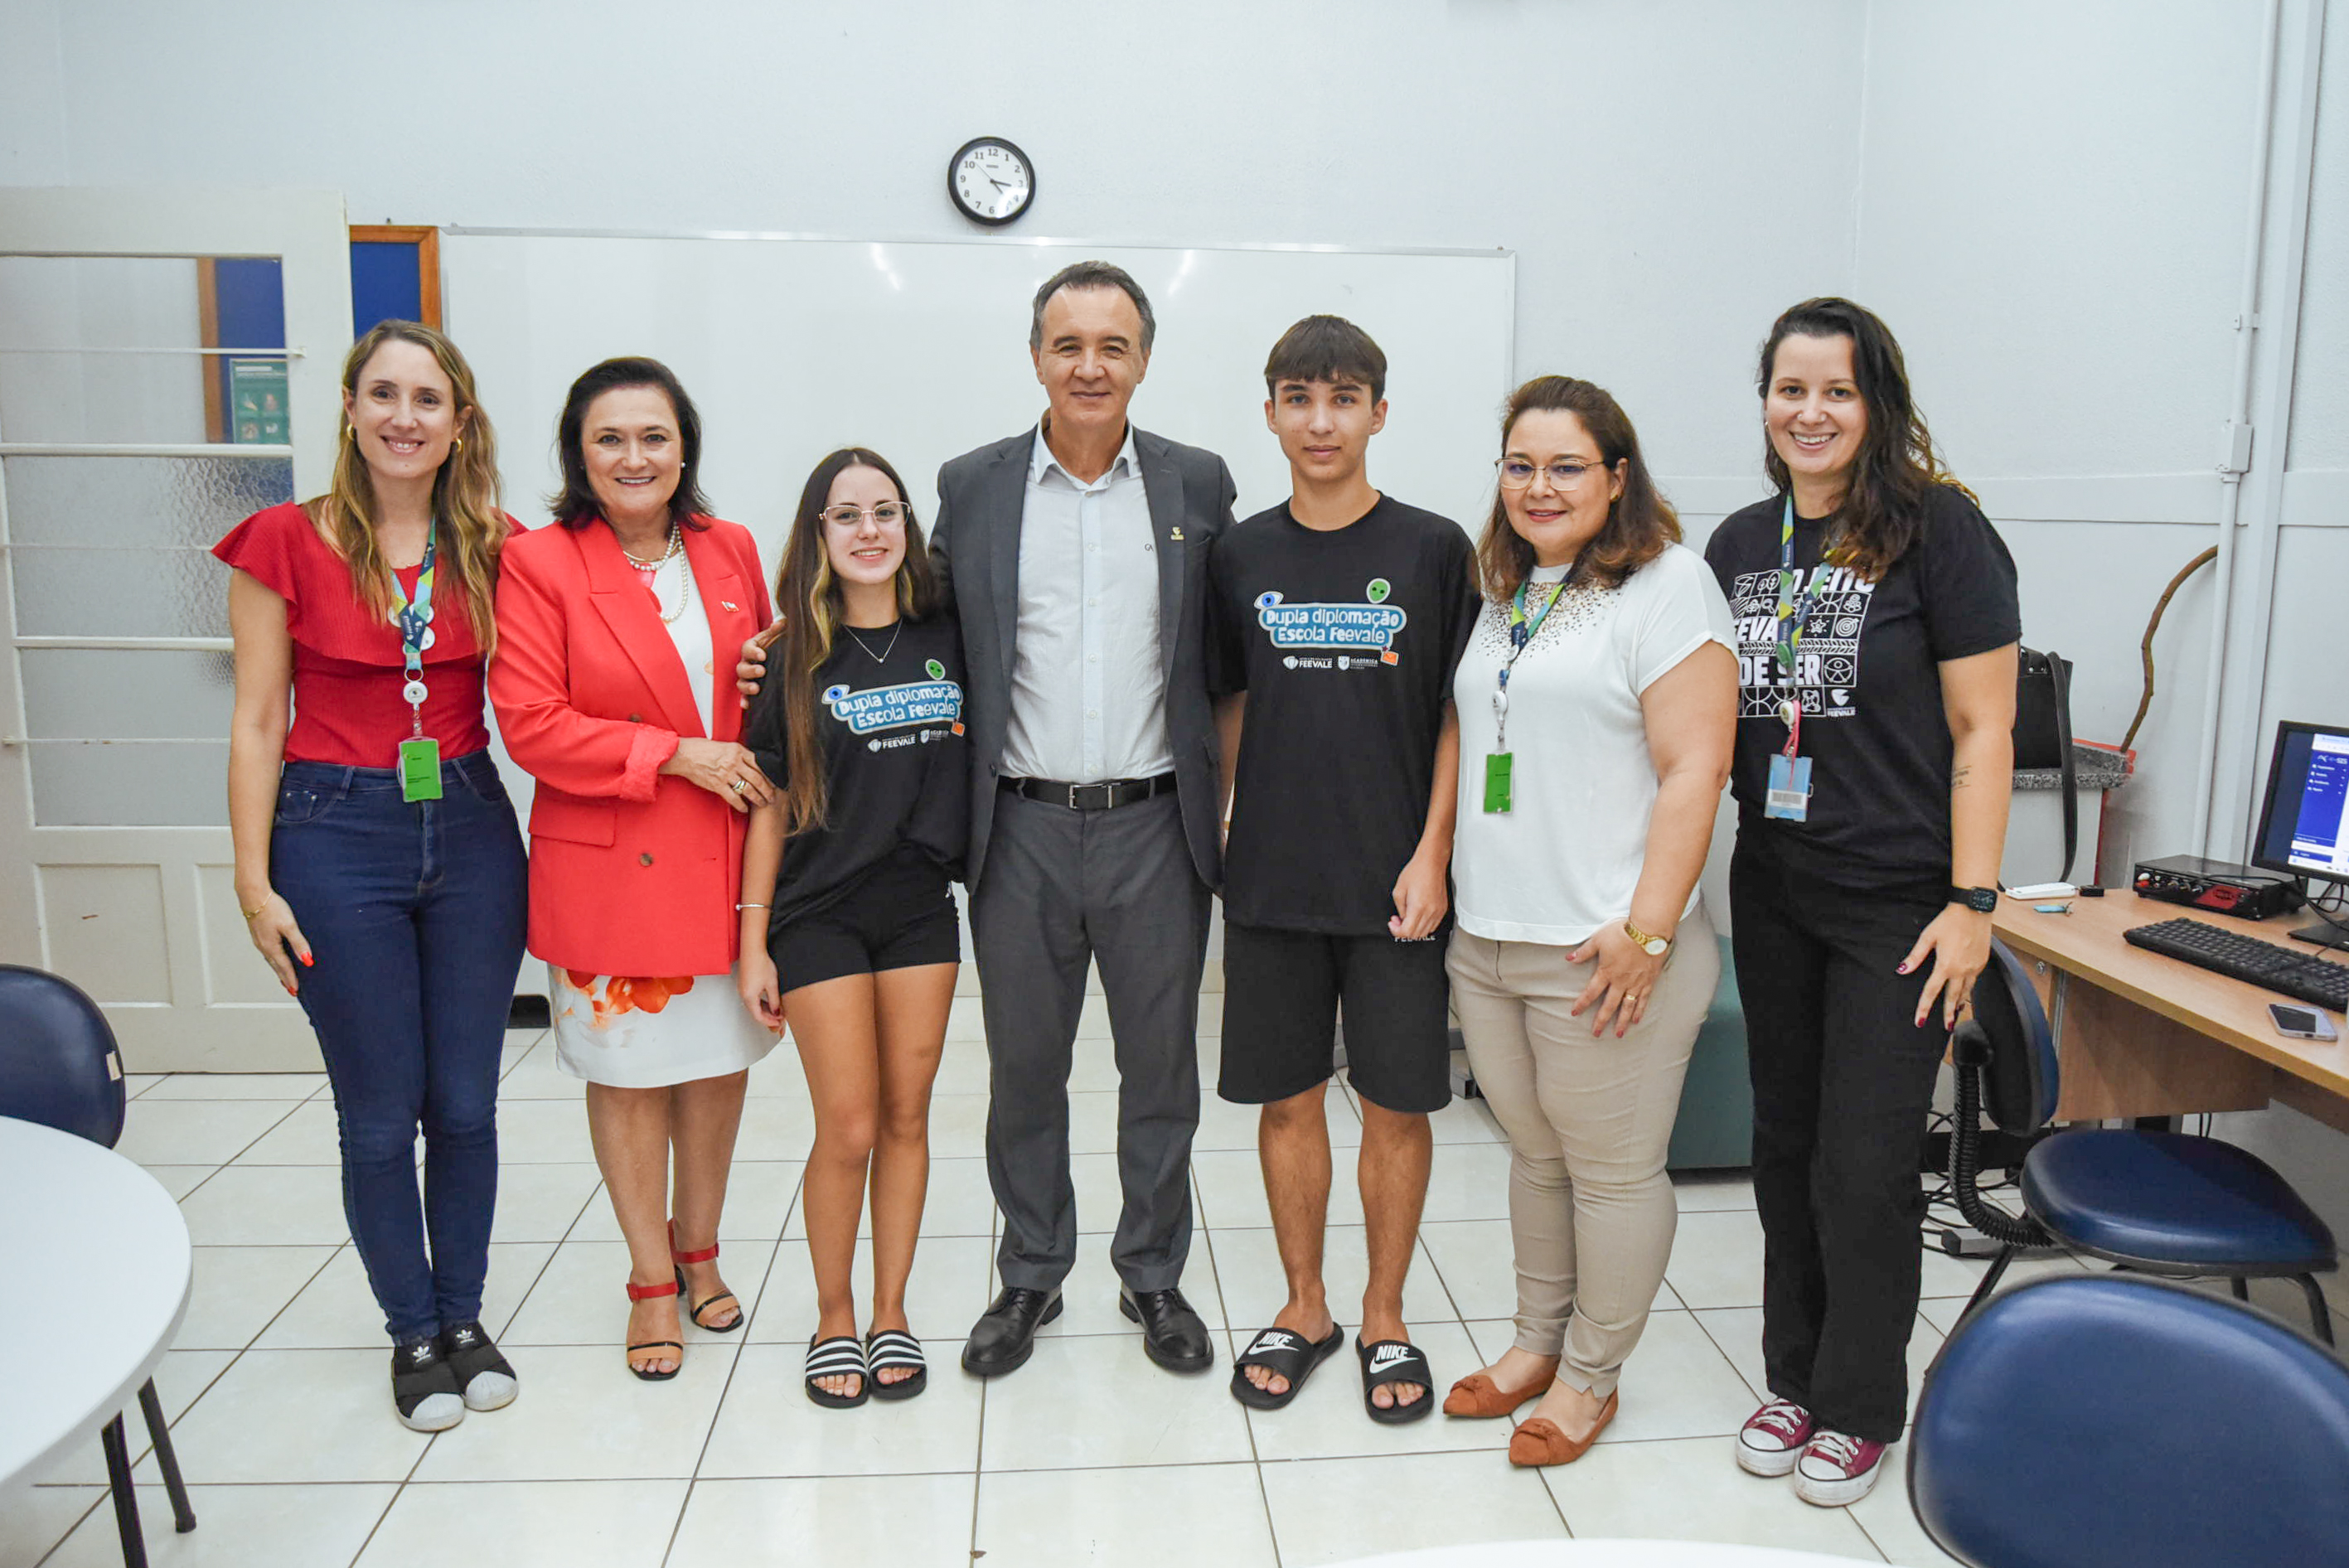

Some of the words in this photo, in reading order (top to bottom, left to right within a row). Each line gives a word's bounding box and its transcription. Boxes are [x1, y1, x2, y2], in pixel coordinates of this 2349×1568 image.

[988, 148, 999, 157] 12
[964, 161, 976, 169] 10
[1015, 165, 1020, 173] 2
[960, 175, 966, 183] 9
[964, 190, 970, 198] 8
[975, 201, 981, 209] 7
[1266, 610, 1309, 626] Dupla
[1312, 608, 1400, 627] diplomação
[1277, 627, 1325, 642] Escola
[1329, 627, 1386, 643] Feevale
[1299, 661, 1333, 669] FEEVALE
[1739, 656, 1770, 686] DE
[838, 694, 882, 714] Dupla
[885, 685, 961, 705] diplomação
[856, 707, 906, 728] Escola
[908, 701, 956, 719] Feevale
[882, 736, 916, 749] FEEVALE
[1259, 1332, 1293, 1346] NIKE
[1375, 1344, 1409, 1362] NIKE
